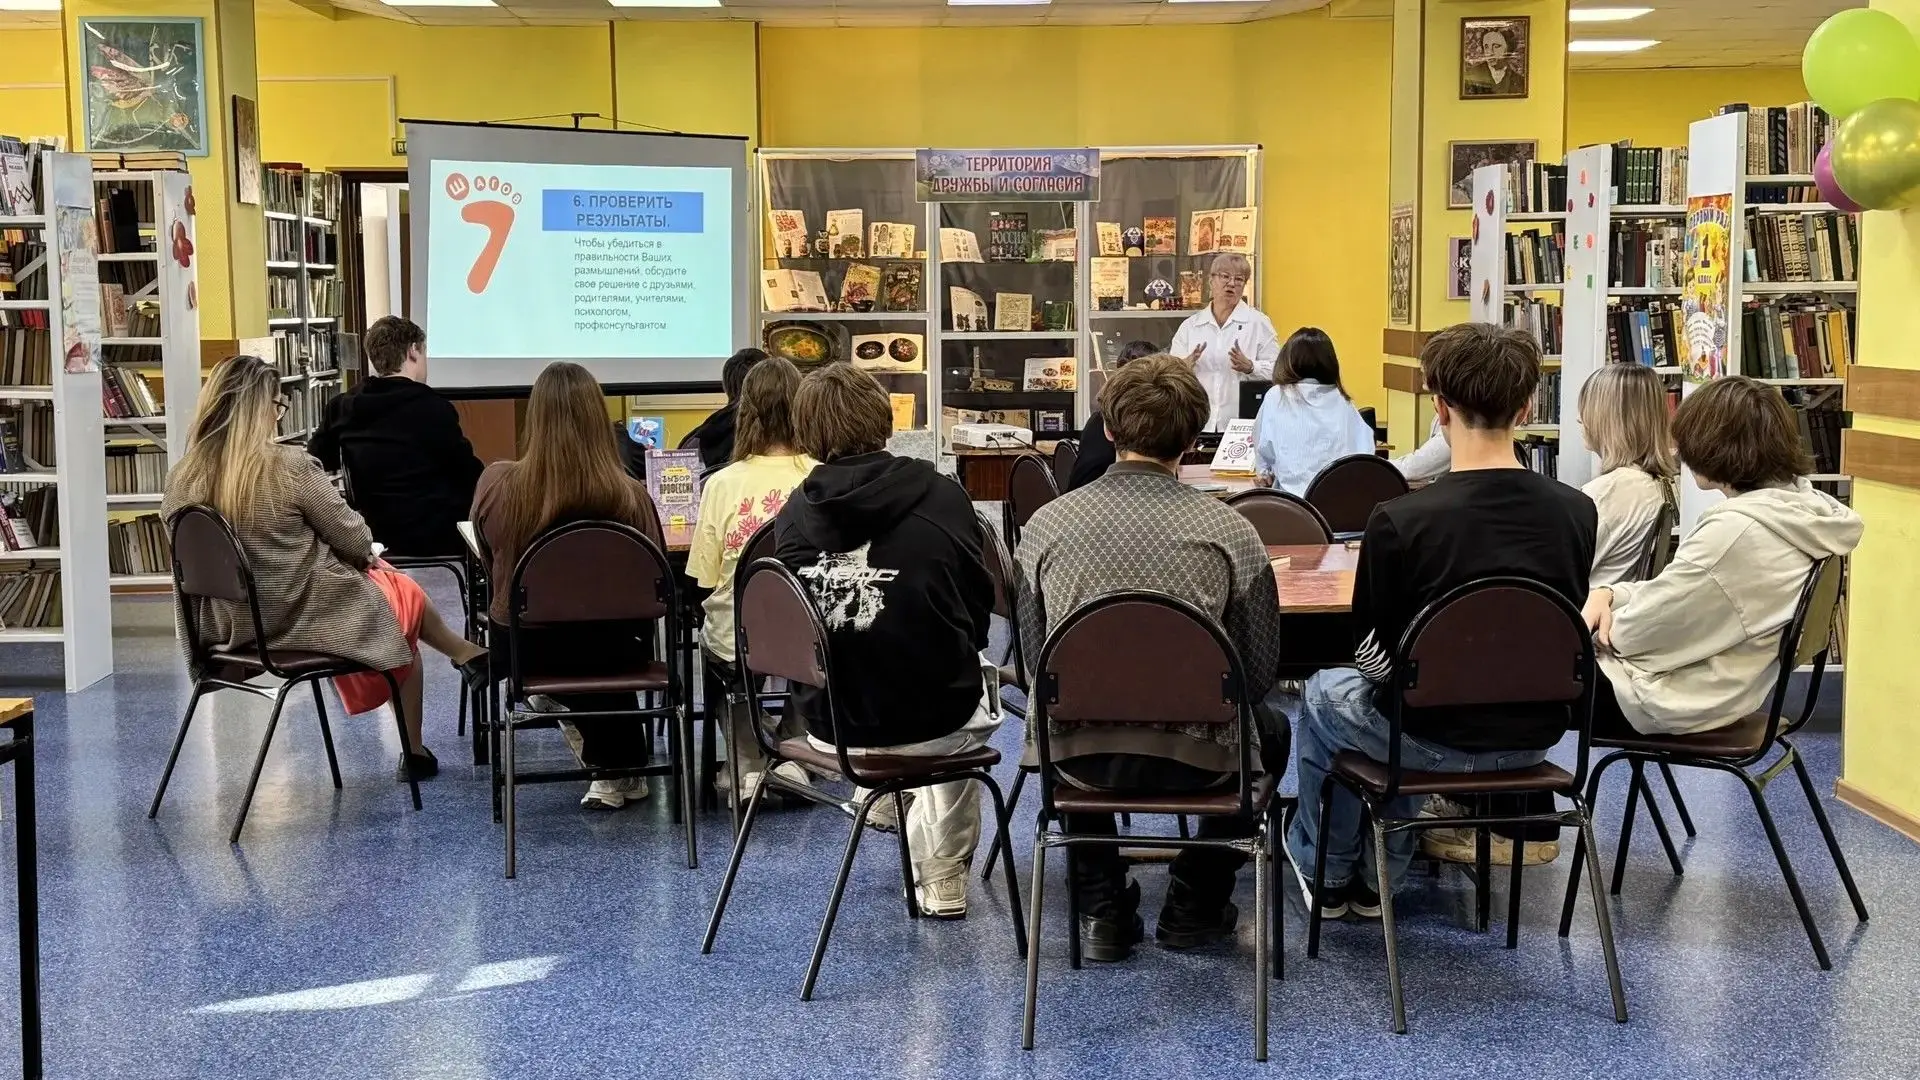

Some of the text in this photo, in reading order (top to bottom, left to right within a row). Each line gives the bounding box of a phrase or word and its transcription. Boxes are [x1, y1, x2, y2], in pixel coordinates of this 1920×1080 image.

[966, 156, 1052, 172] ТЕРРИТОРИЯ
[933, 177, 1083, 193] ДРУЖБЫ И СОГЛАСИЯ
[573, 195, 673, 209] 6. ПРОВЕРИТЬ
[576, 213, 670, 228] РЕЗУЛЬТАТЫ.
[574, 237, 605, 248] Чтобы
[607, 238, 654, 249] убедиться
[991, 231, 1027, 245] РОССИЯ
[574, 252, 672, 263] правильности Ваших
[645, 266, 687, 278] обсудите
[574, 280, 596, 289] свое
[598, 280, 640, 291] решение
[649, 281, 696, 292] друзьями,
[574, 293, 687, 305] родителями, учителями,
[574, 307, 632, 317] психологом,
[574, 320, 667, 331] профконсультантом
